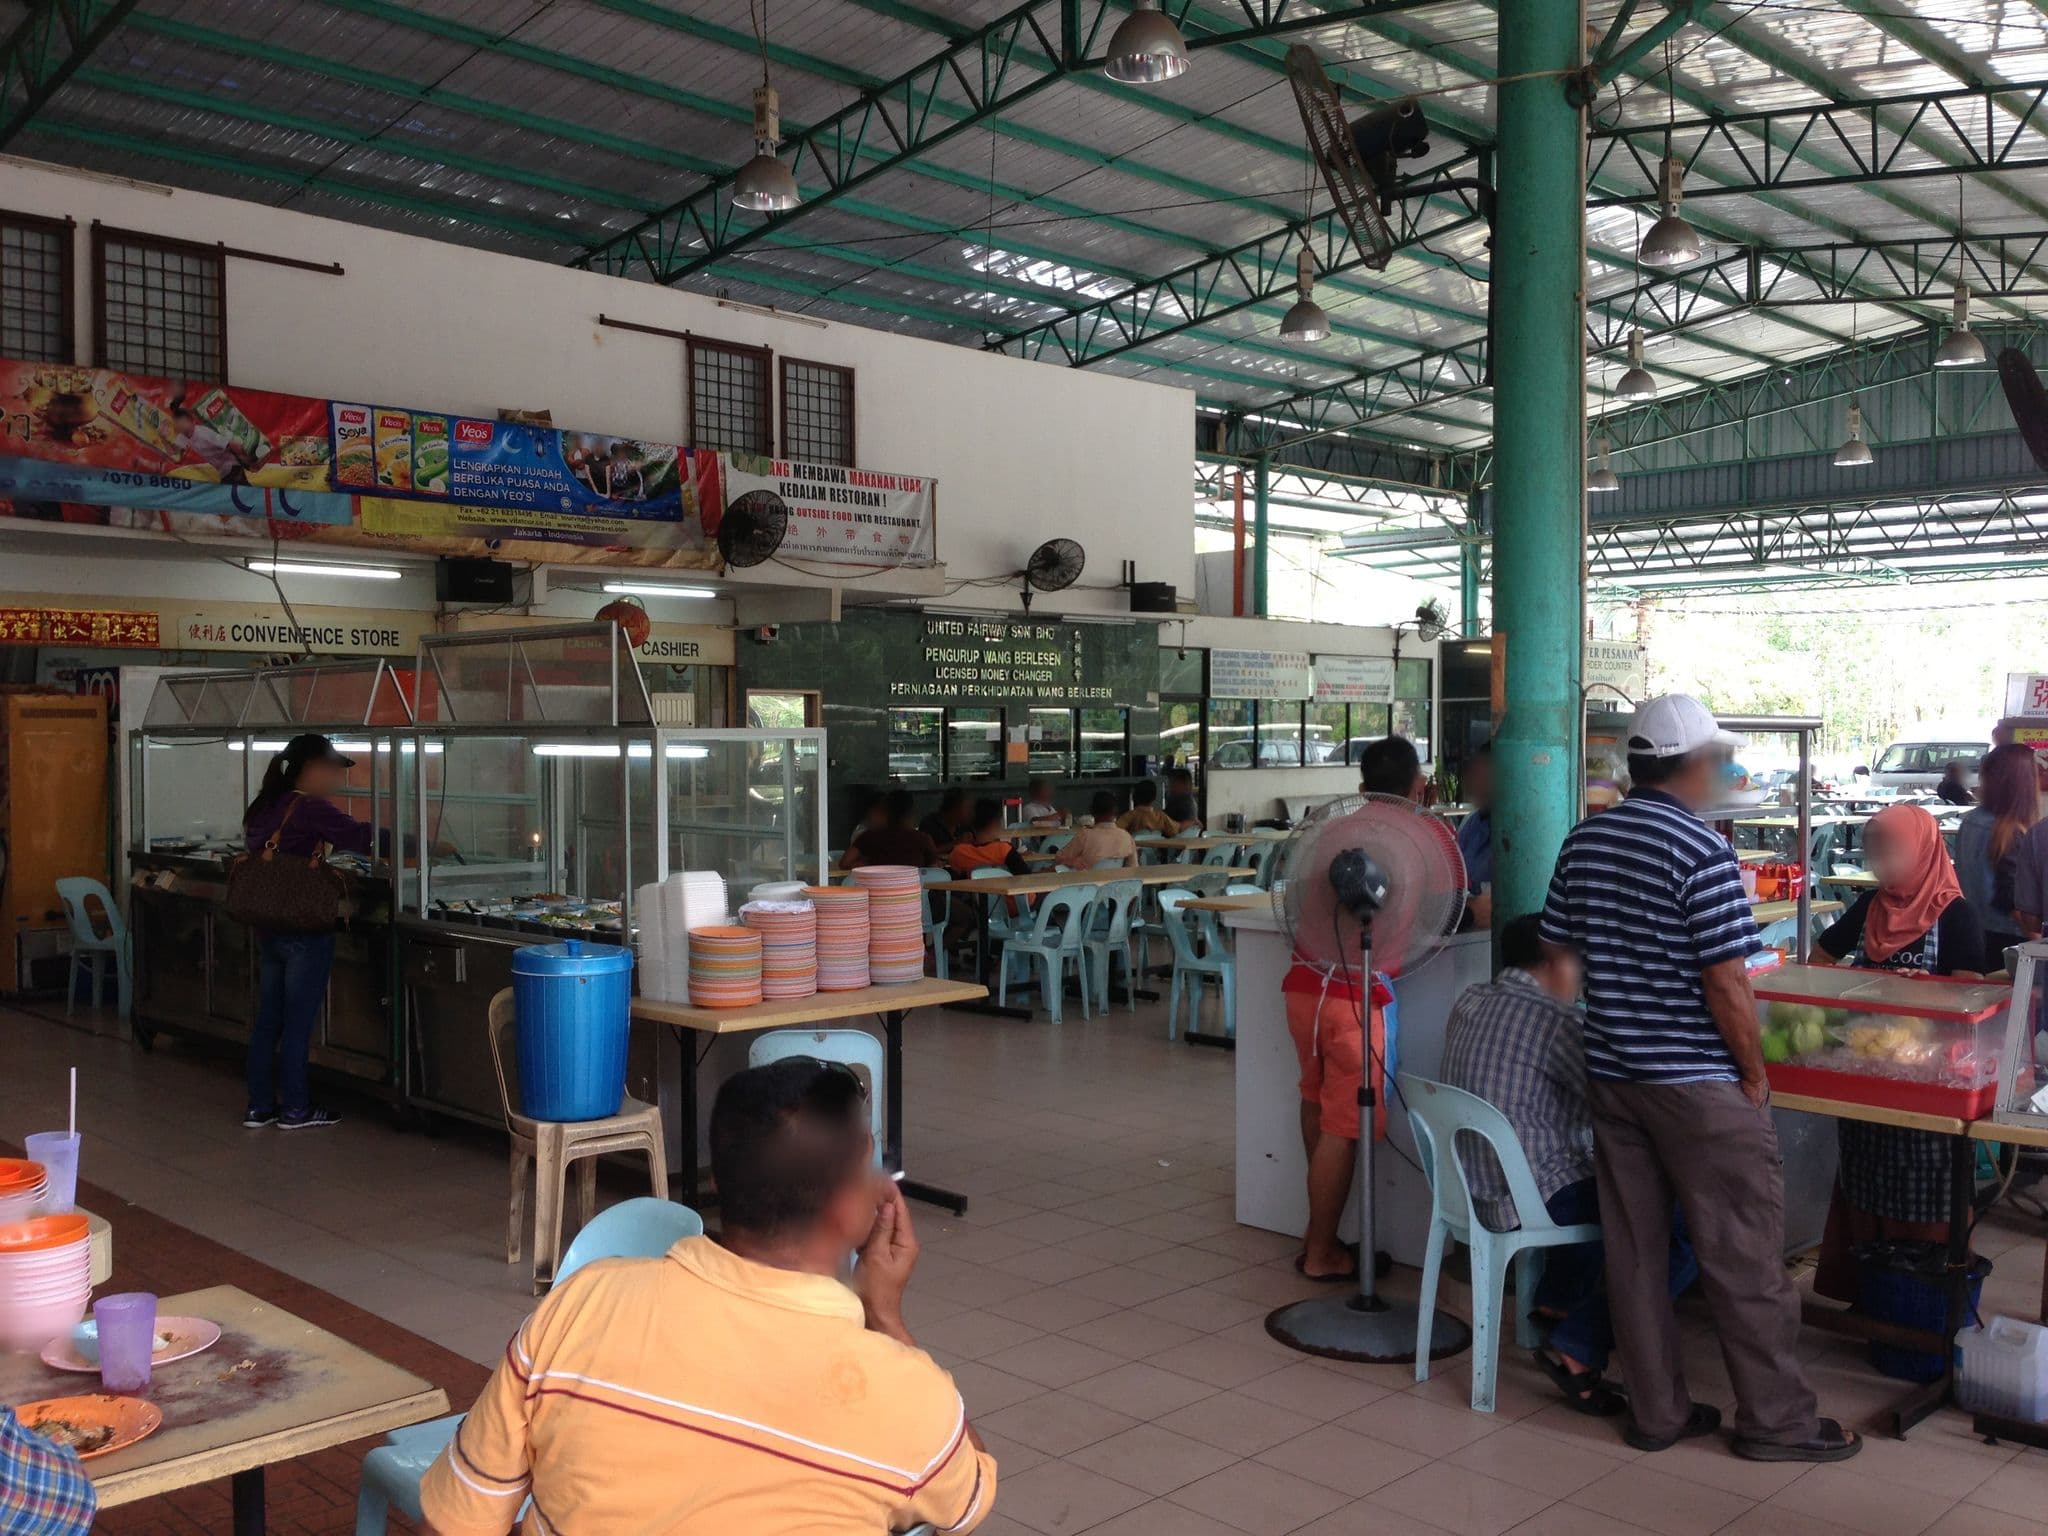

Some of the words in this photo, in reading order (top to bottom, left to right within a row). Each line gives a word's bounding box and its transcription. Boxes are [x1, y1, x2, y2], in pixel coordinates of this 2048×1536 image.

[338, 427, 367, 440] Soya
[461, 424, 488, 439] Yeo's
[453, 458, 521, 475] LENGKAPKAN
[524, 467, 562, 480] JUADAH
[793, 463, 847, 484] MEMBAWA
[849, 470, 896, 490] MAKANAN
[898, 477, 922, 493] LUAR
[453, 473, 505, 486] BERBUKA
[507, 477, 541, 490] PUASA
[544, 482, 570, 493] ANDA
[454, 487, 499, 499] DENGAN
[779, 481, 826, 501] KEDALAM
[829, 487, 880, 507] RESTORAN
[796, 507, 831, 520] OUTSIDE
[832, 510, 853, 522] FOOD
[854, 513, 872, 524] INTO
[512, 527, 543, 538] Jakarta
[188, 622, 227, 643] 便利店
[231, 624, 345, 646] CONVENIENCE
[351, 629, 401, 648] STORE
[927, 620, 964, 637] UNITED
[967, 622, 1008, 639] FAIRWAY
[1011, 625, 1032, 640] SDN
[641, 640, 701, 658] CASHIER
[925, 647, 980, 664] PENGURUP
[982, 650, 1012, 666] WANG
[1014, 651, 1062, 667] BERLESEN
[1602, 648, 1641, 662] PESANAN
[935, 666, 978, 681] LICENSED
[980, 668, 1010, 682] MONEY
[1012, 670, 1053, 683] CHANGER
[890, 682, 958, 697] PERNIAGAAN
[961, 684, 1034, 698] PERKHIDMATAN
[1037, 685, 1064, 699] WANG
[1067, 687, 1113, 700] BERLESEN
